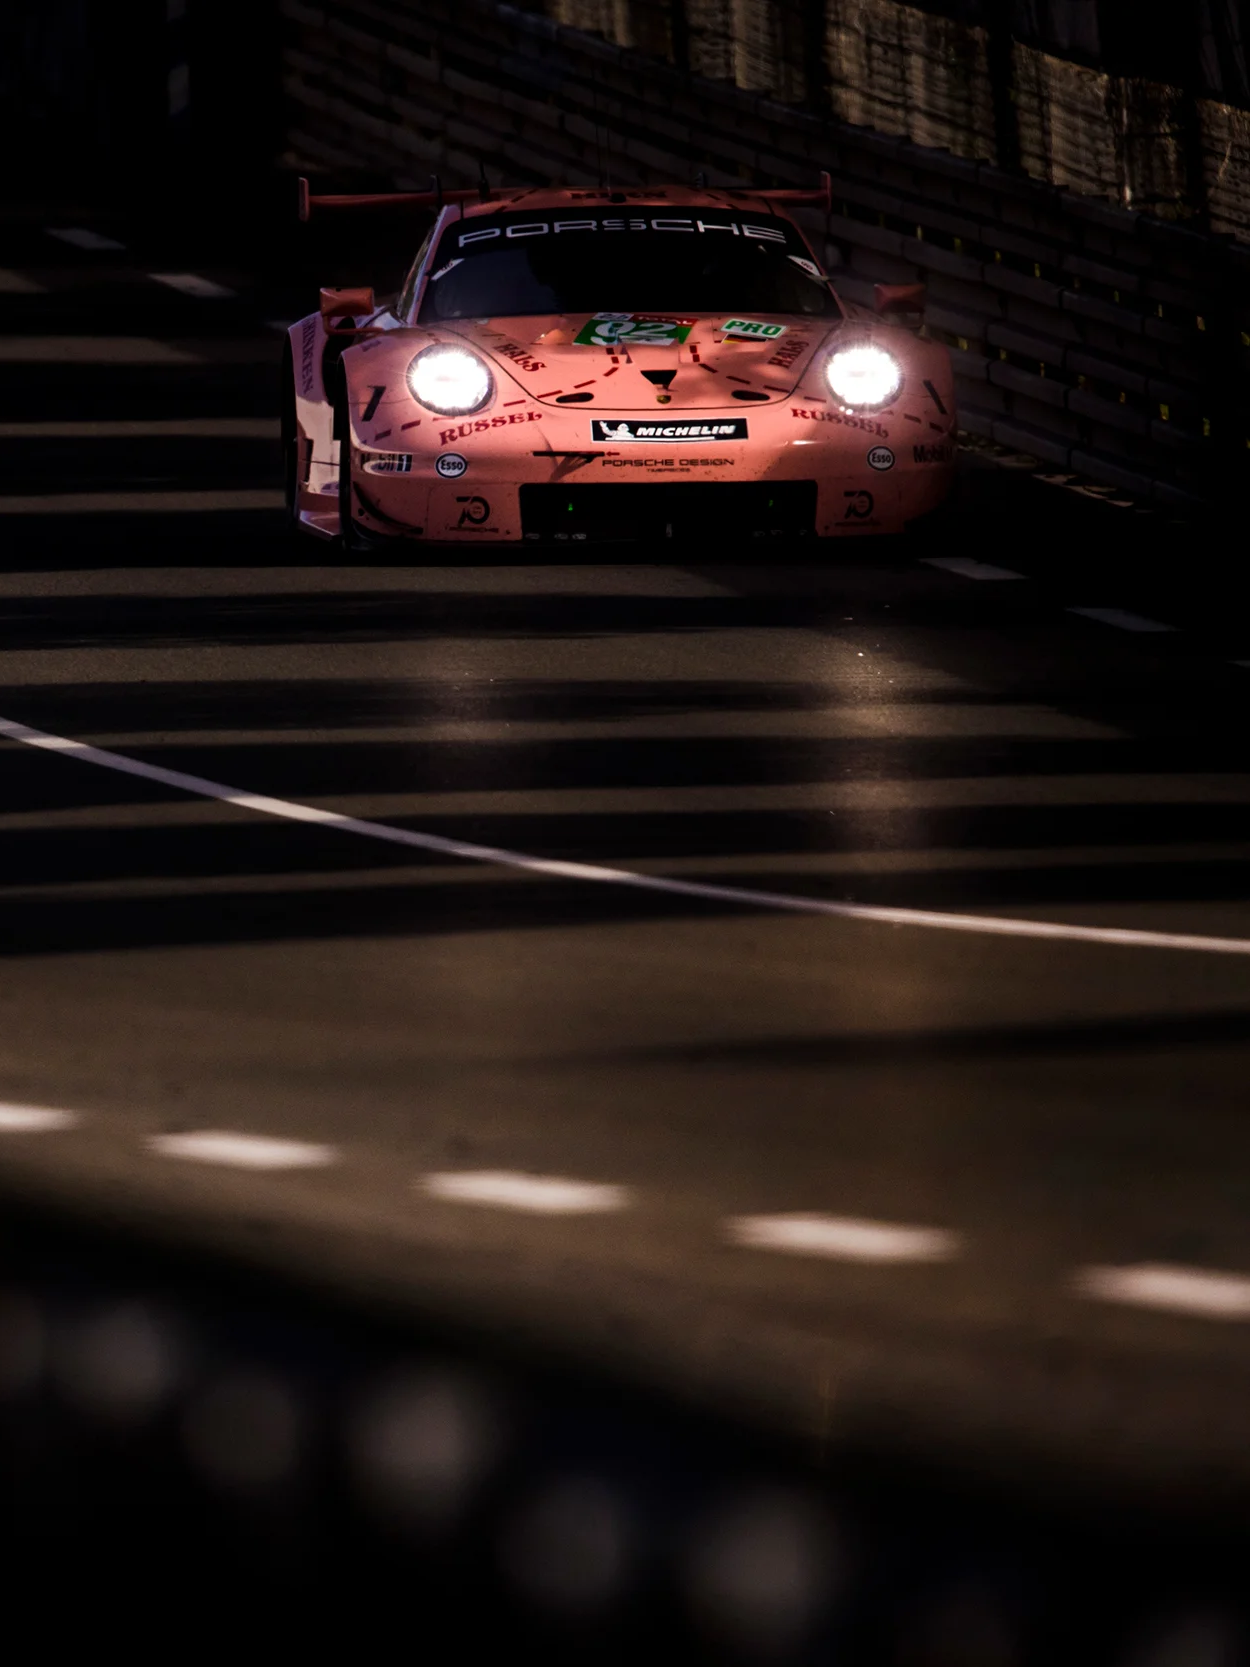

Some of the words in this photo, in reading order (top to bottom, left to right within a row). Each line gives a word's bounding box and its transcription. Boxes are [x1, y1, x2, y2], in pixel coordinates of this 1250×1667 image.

[458, 218, 787, 248] PORSCHE
[590, 321, 677, 345] 92
[725, 320, 780, 336] PRO
[492, 343, 547, 372] HALS
[768, 340, 809, 369] HALS
[636, 424, 737, 437] MICHELIN
[440, 460, 463, 470] Esso
[602, 459, 674, 467] PORSCHE
[679, 458, 735, 466] DESIGN
[871, 452, 891, 463] Esso
[456, 496, 490, 527] 70
[844, 490, 874, 520] 70
